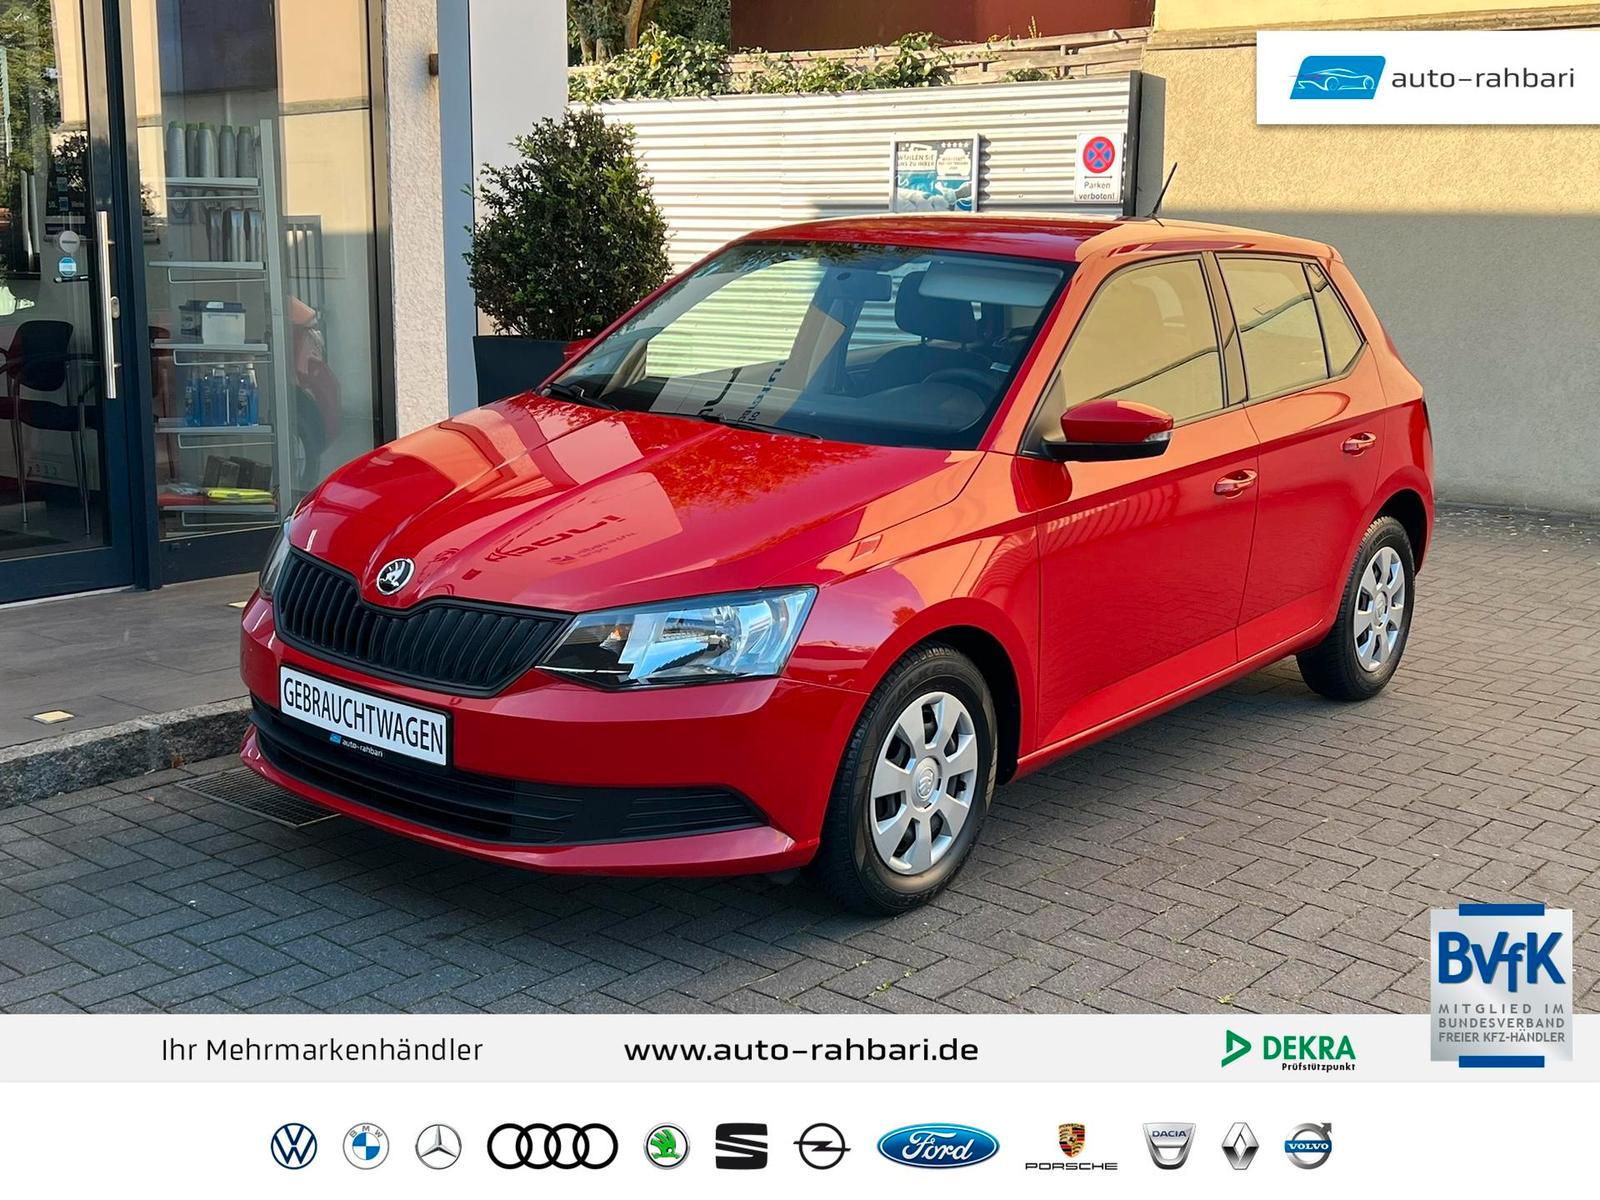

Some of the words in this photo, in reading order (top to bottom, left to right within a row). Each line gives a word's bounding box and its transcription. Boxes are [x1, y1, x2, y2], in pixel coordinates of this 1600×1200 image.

[1084, 181, 1111, 189] Parken
[1079, 192, 1115, 200] verboten!
[283, 677, 444, 755] GEBRAUCHTWAGEN
